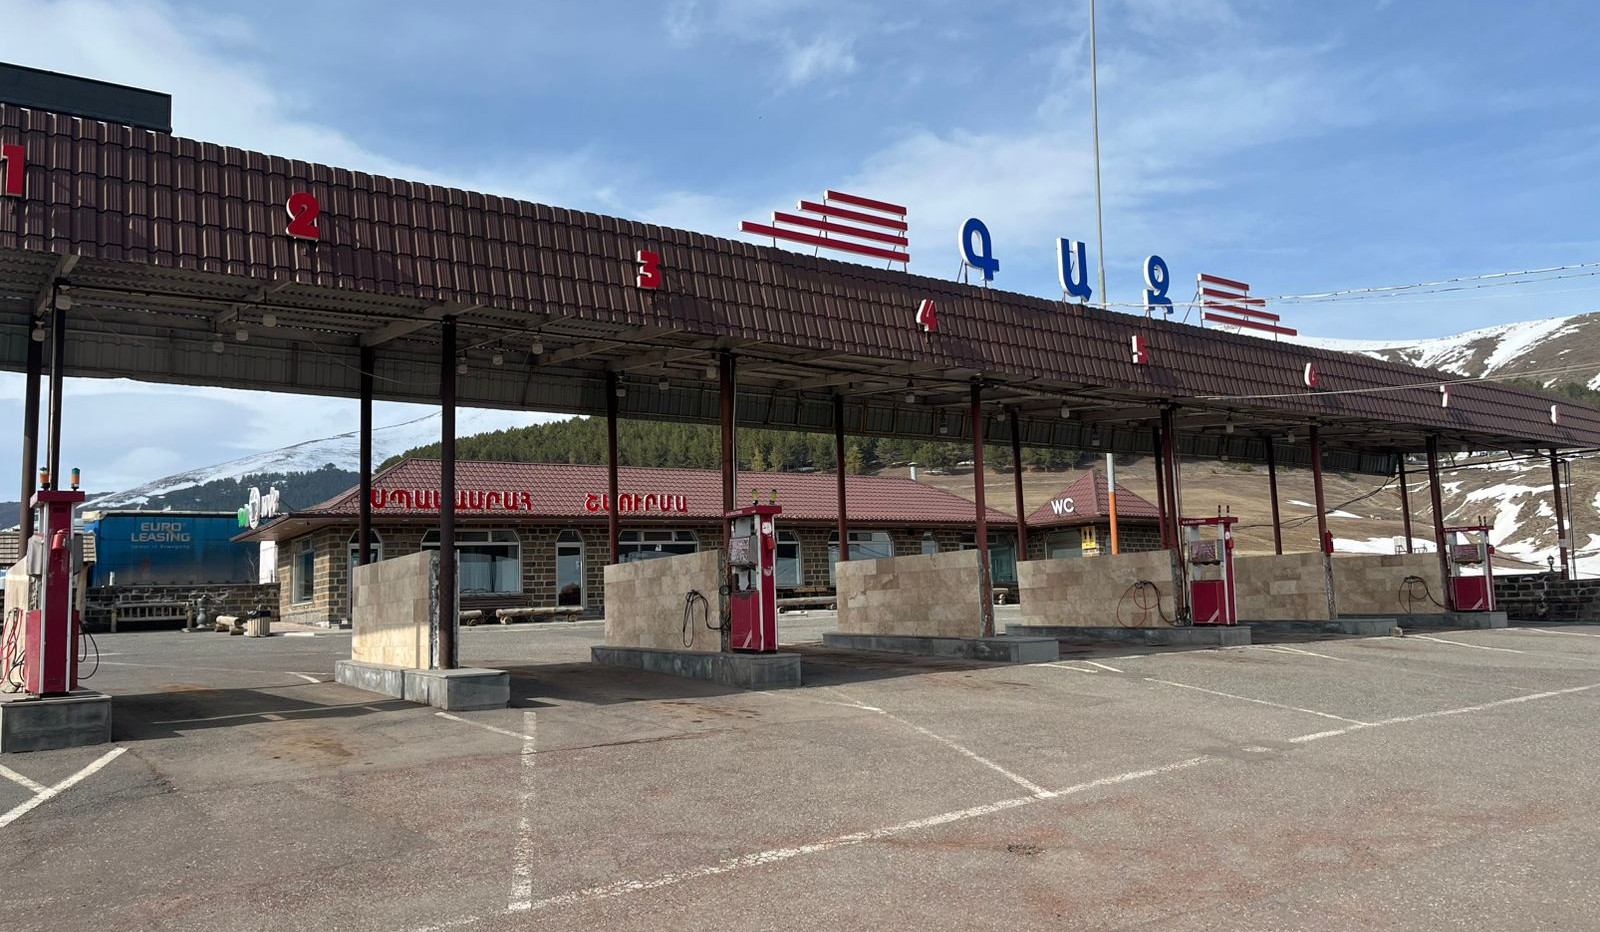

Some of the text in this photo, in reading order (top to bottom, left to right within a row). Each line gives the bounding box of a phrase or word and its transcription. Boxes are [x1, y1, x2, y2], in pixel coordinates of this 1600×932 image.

[1, 143, 25, 197] 1
[286, 192, 320, 240] 2
[637, 250, 662, 289] 3
[958, 217, 1174, 314] ԳԱԶ
[916, 299, 937, 331] 4
[1131, 335, 1148, 364] 5
[1304, 362, 1318, 387] 6
[1051, 498, 1074, 514] WC
[131, 532, 191, 542] LEASING
[141, 522, 182, 532] EURO
